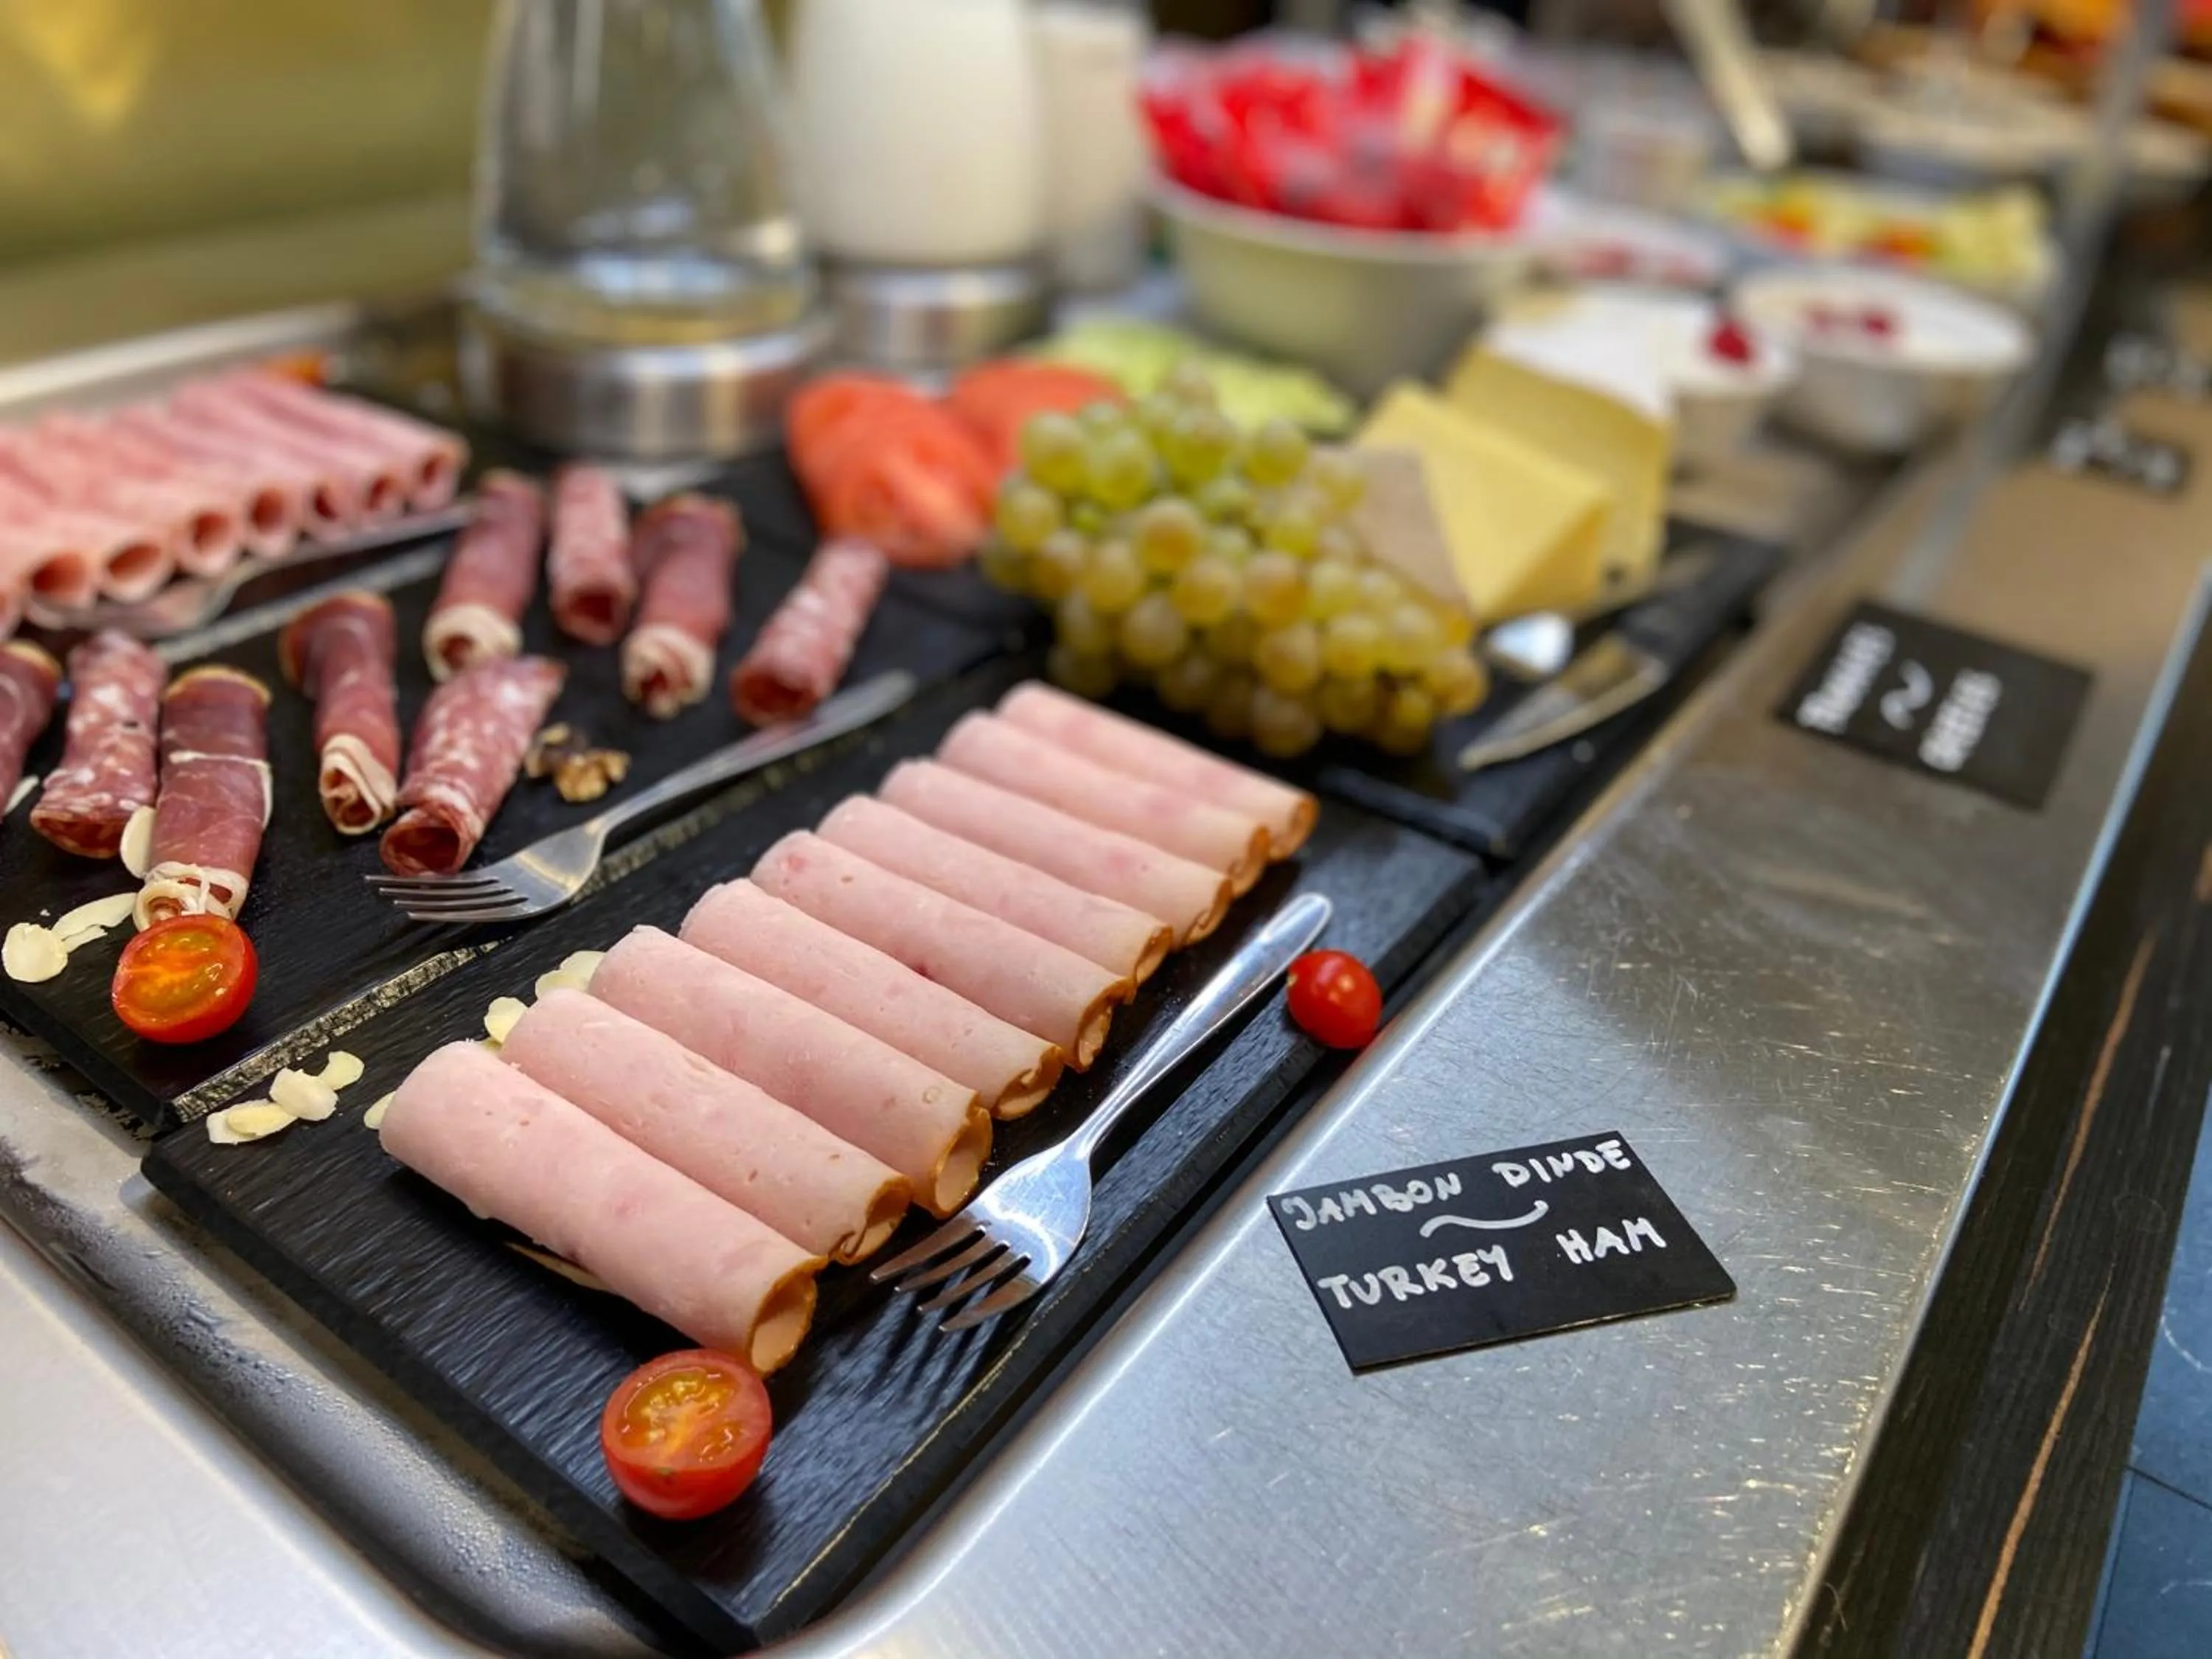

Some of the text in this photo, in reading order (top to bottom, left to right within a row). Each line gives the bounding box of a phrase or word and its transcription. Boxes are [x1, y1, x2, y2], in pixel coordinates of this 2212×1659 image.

[1282, 1140, 1631, 1231] JAMBON DINDE
[1318, 1217, 1667, 1309] TURKEY HAM
